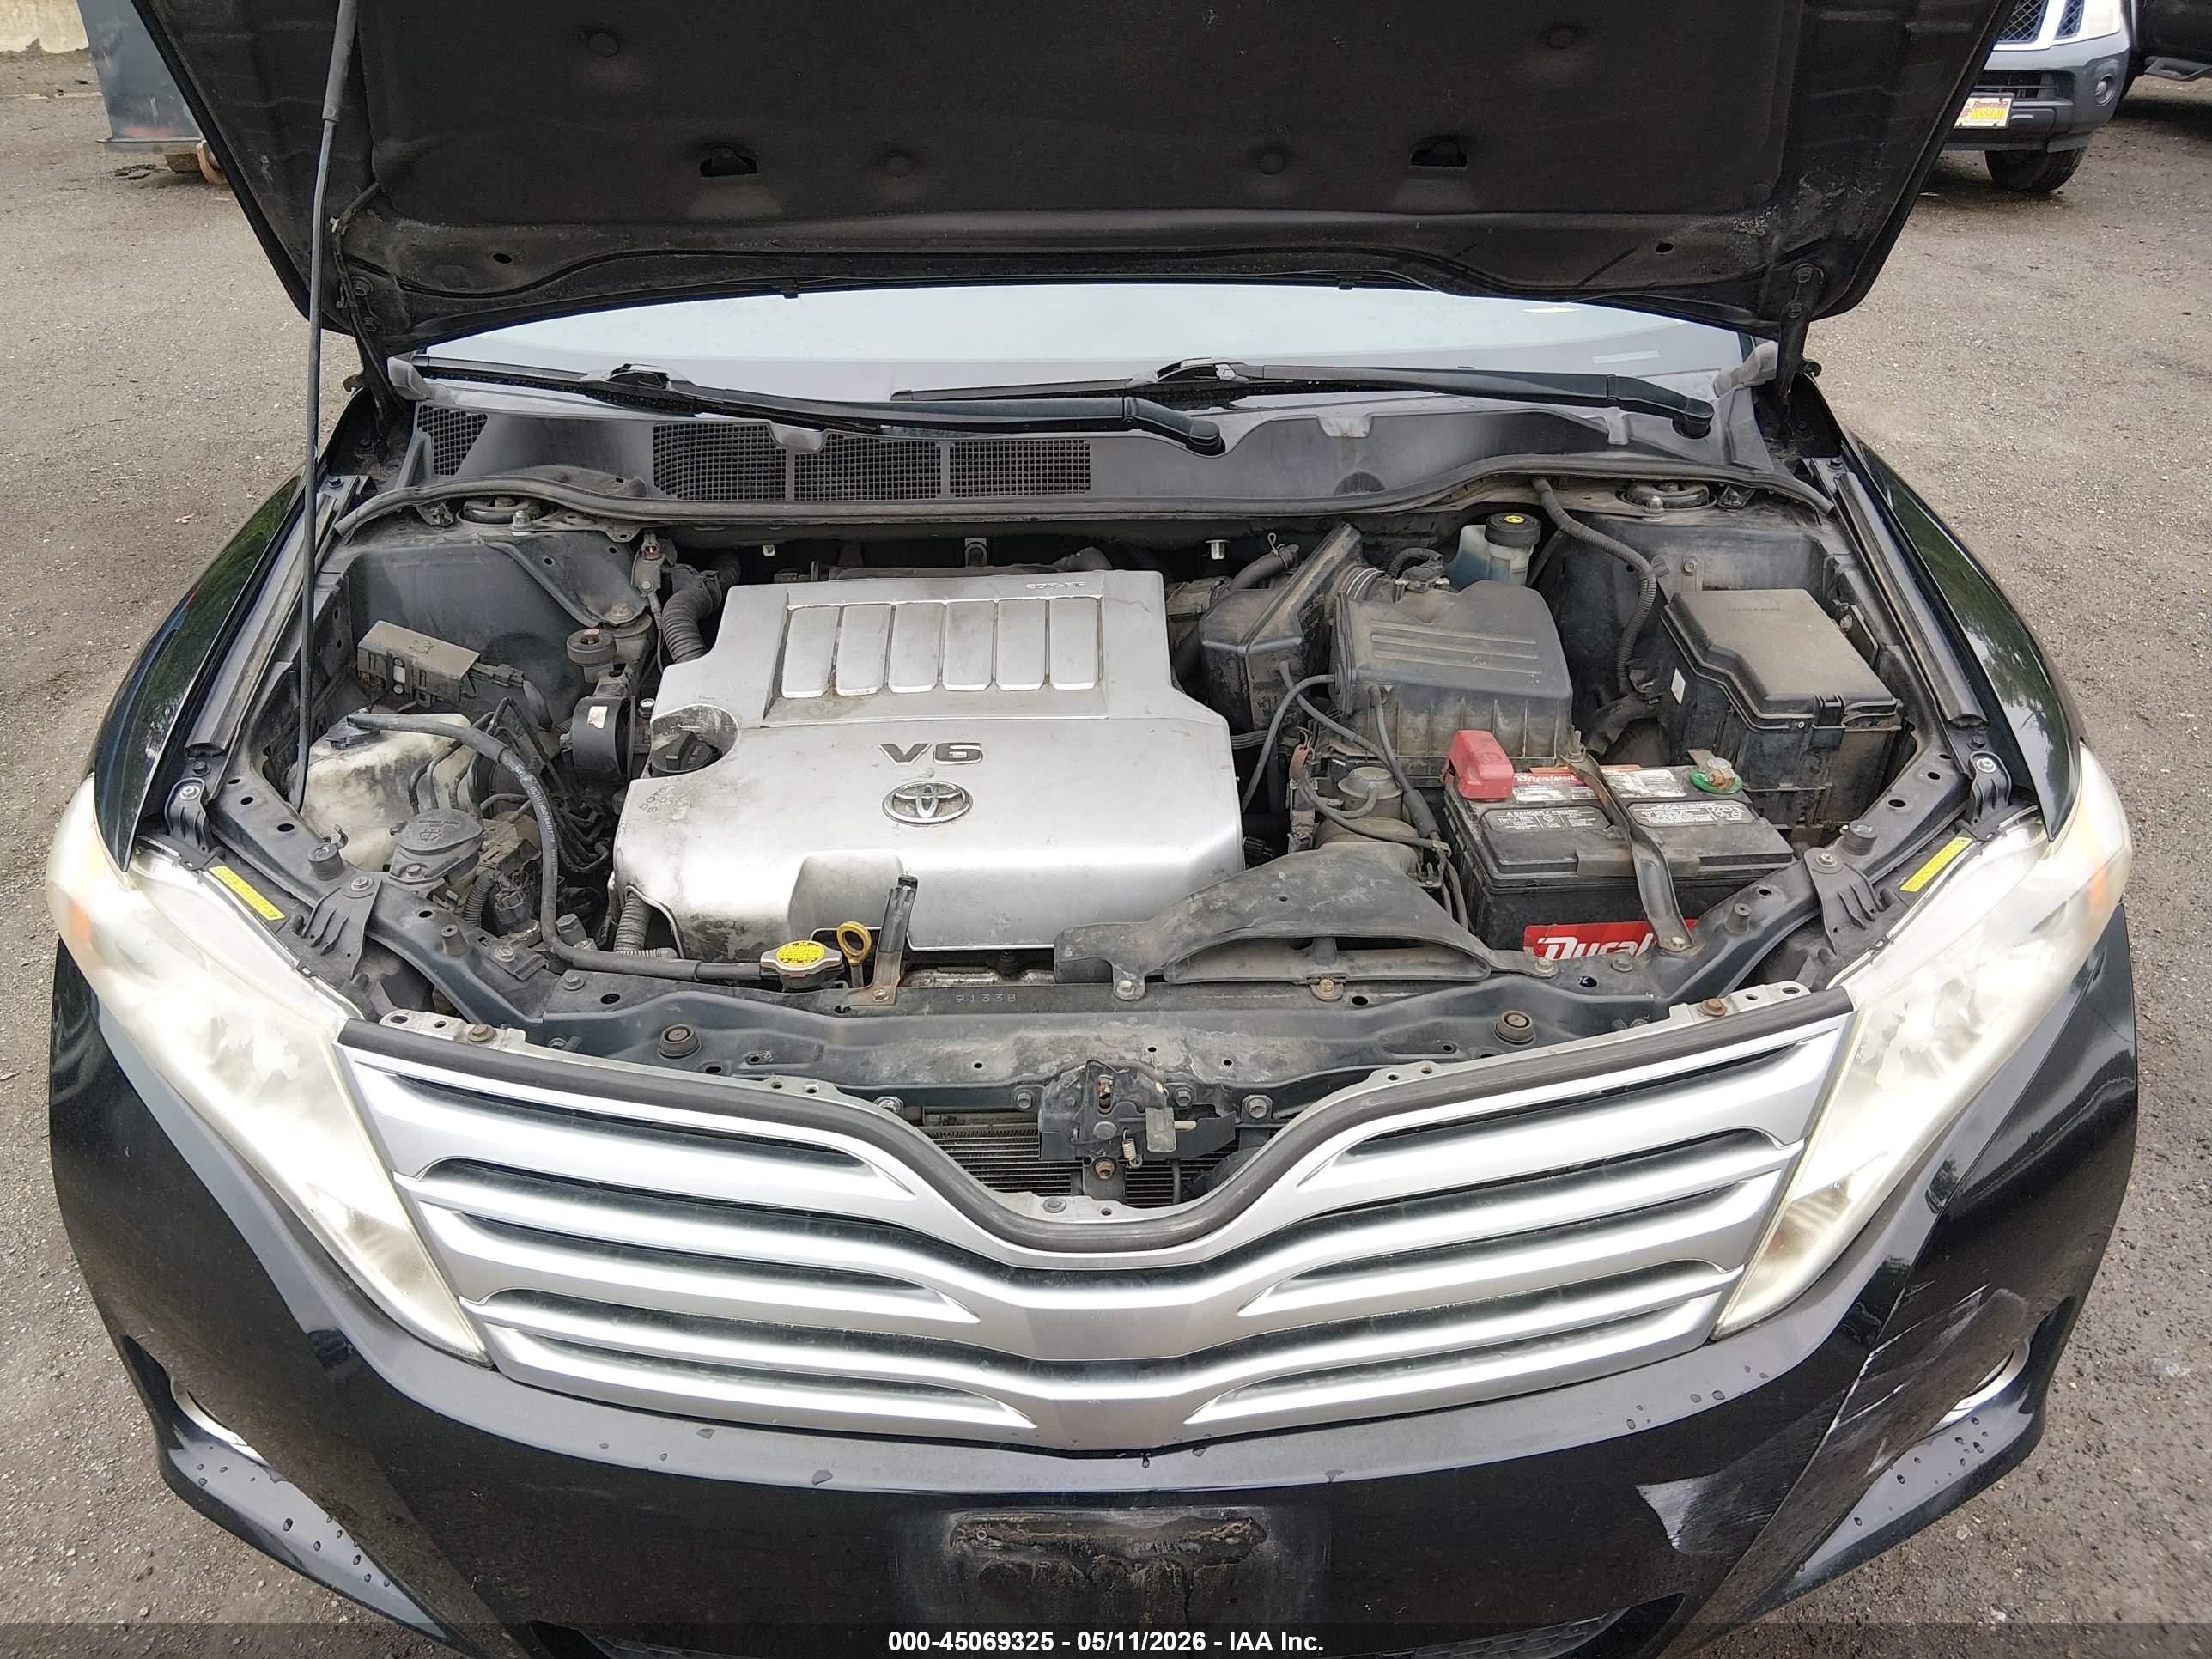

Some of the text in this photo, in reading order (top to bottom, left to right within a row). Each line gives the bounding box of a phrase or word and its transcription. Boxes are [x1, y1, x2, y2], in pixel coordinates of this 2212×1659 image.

[879, 742, 983, 766] V6
[1537, 933, 1654, 961] Dural
[956, 993, 1016, 1003] 91338
